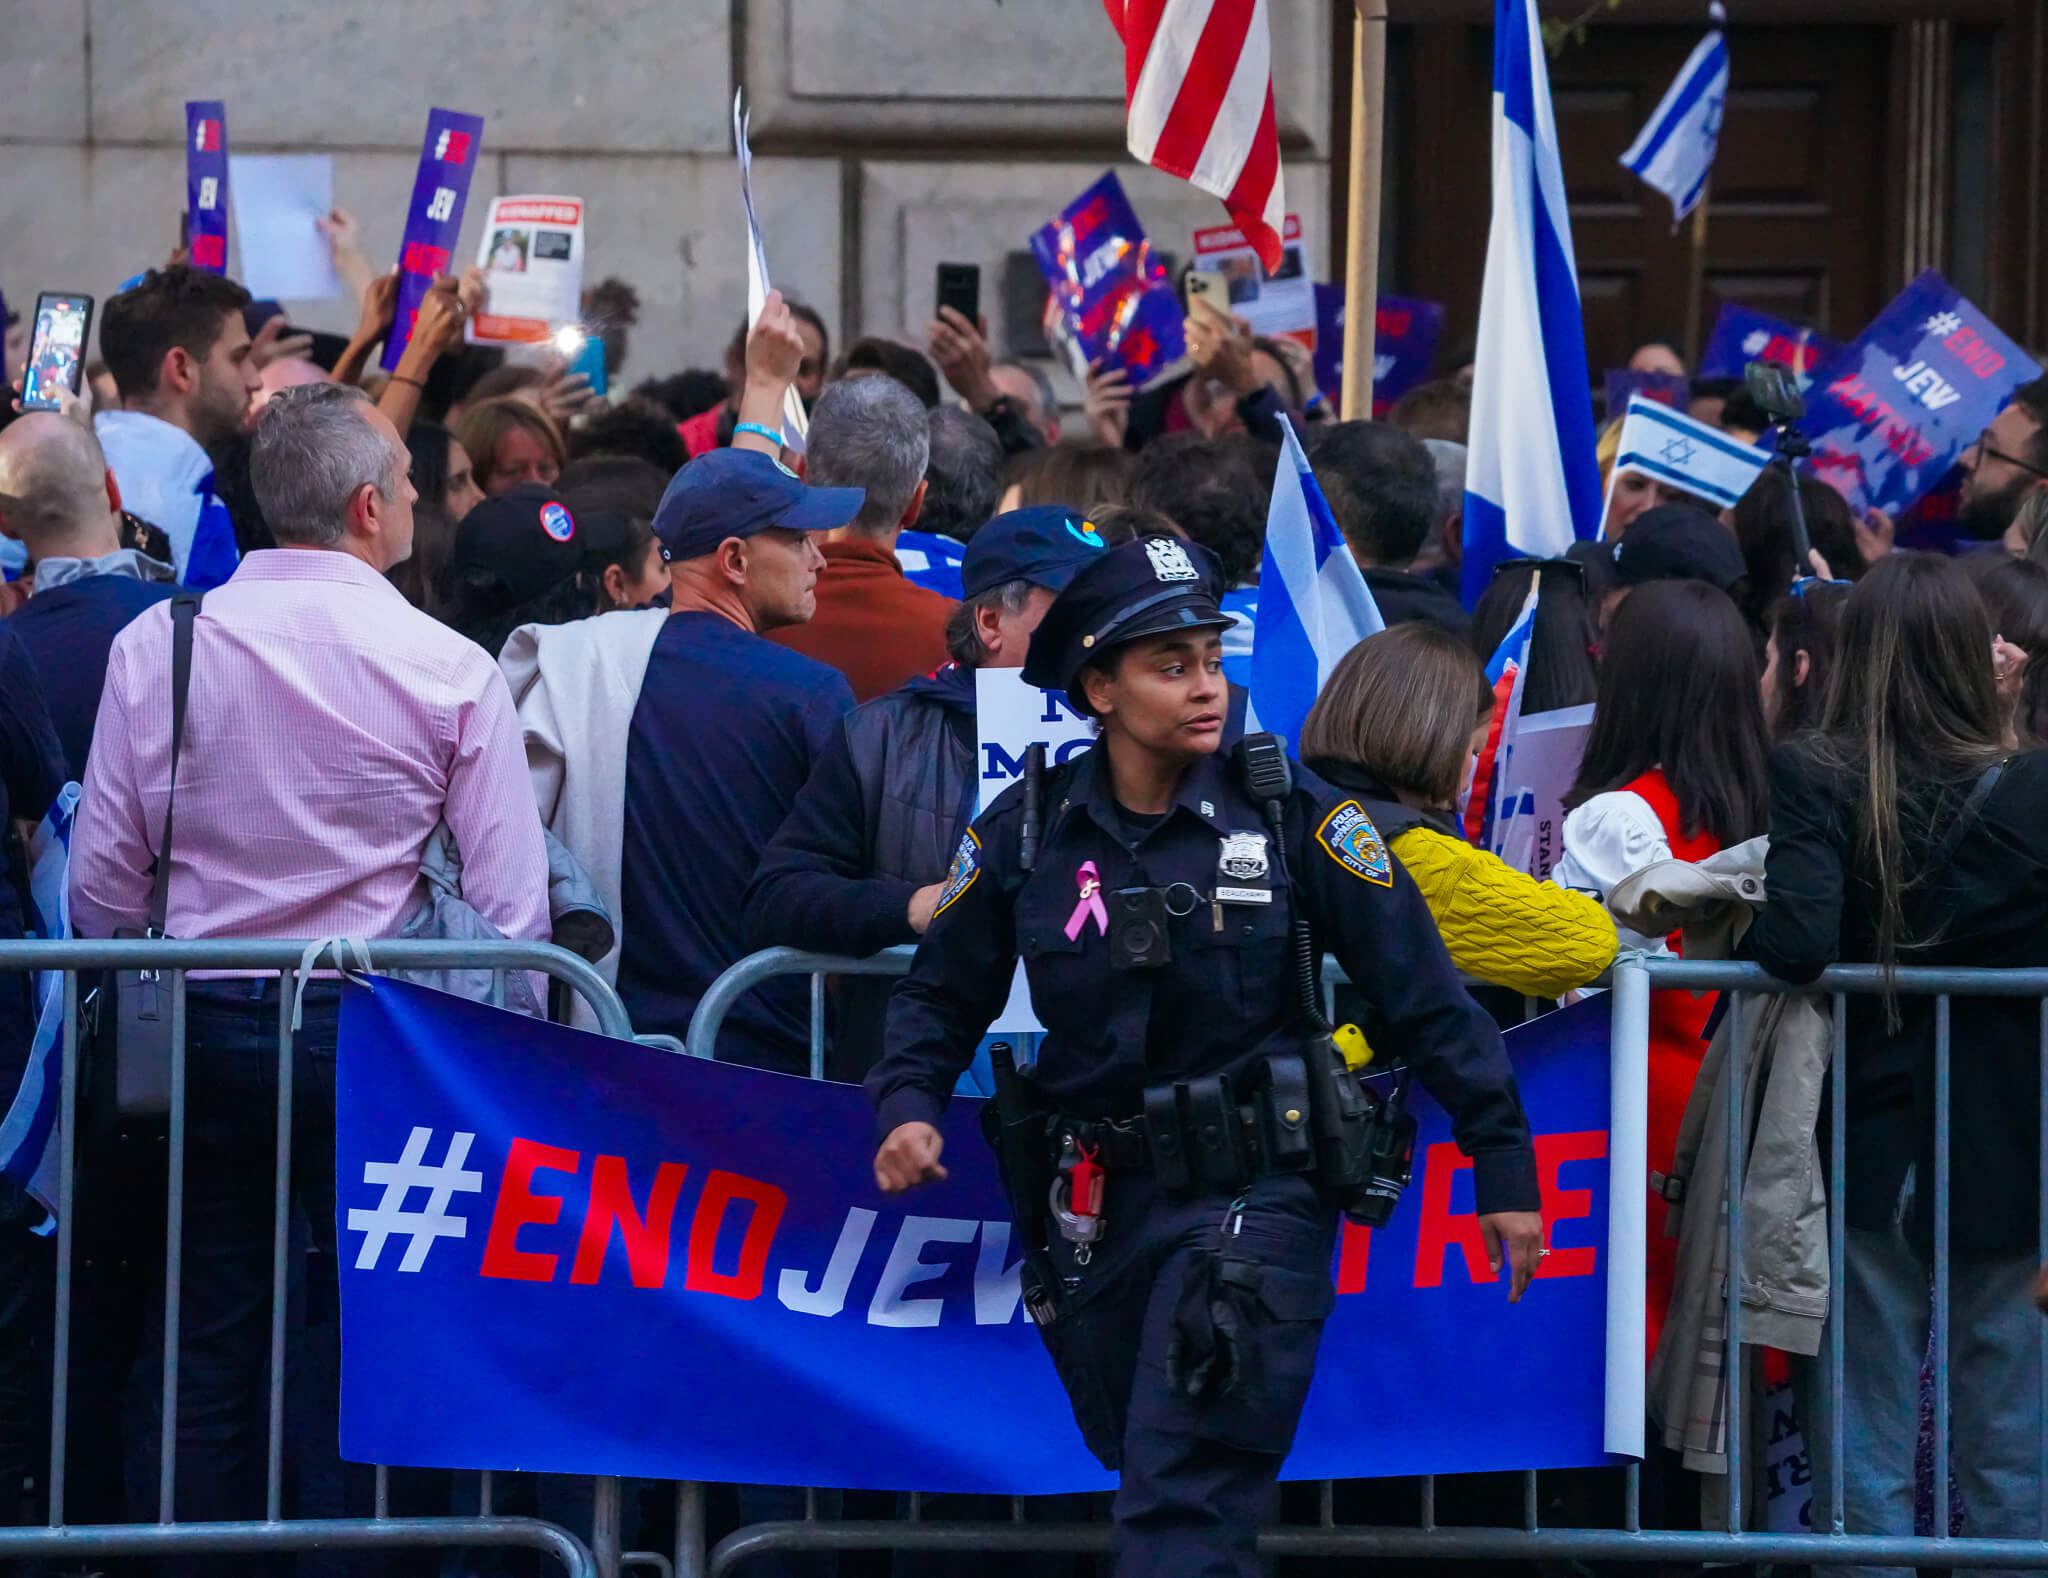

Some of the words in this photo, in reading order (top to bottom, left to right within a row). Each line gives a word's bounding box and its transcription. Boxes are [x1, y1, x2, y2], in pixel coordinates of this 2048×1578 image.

[1925, 311, 2006, 379] #END
[1893, 360, 1961, 410] JEW
[1331, 806, 1358, 830] POLICE
[1342, 855, 1366, 872] CITY
[1365, 868, 1380, 878] OF
